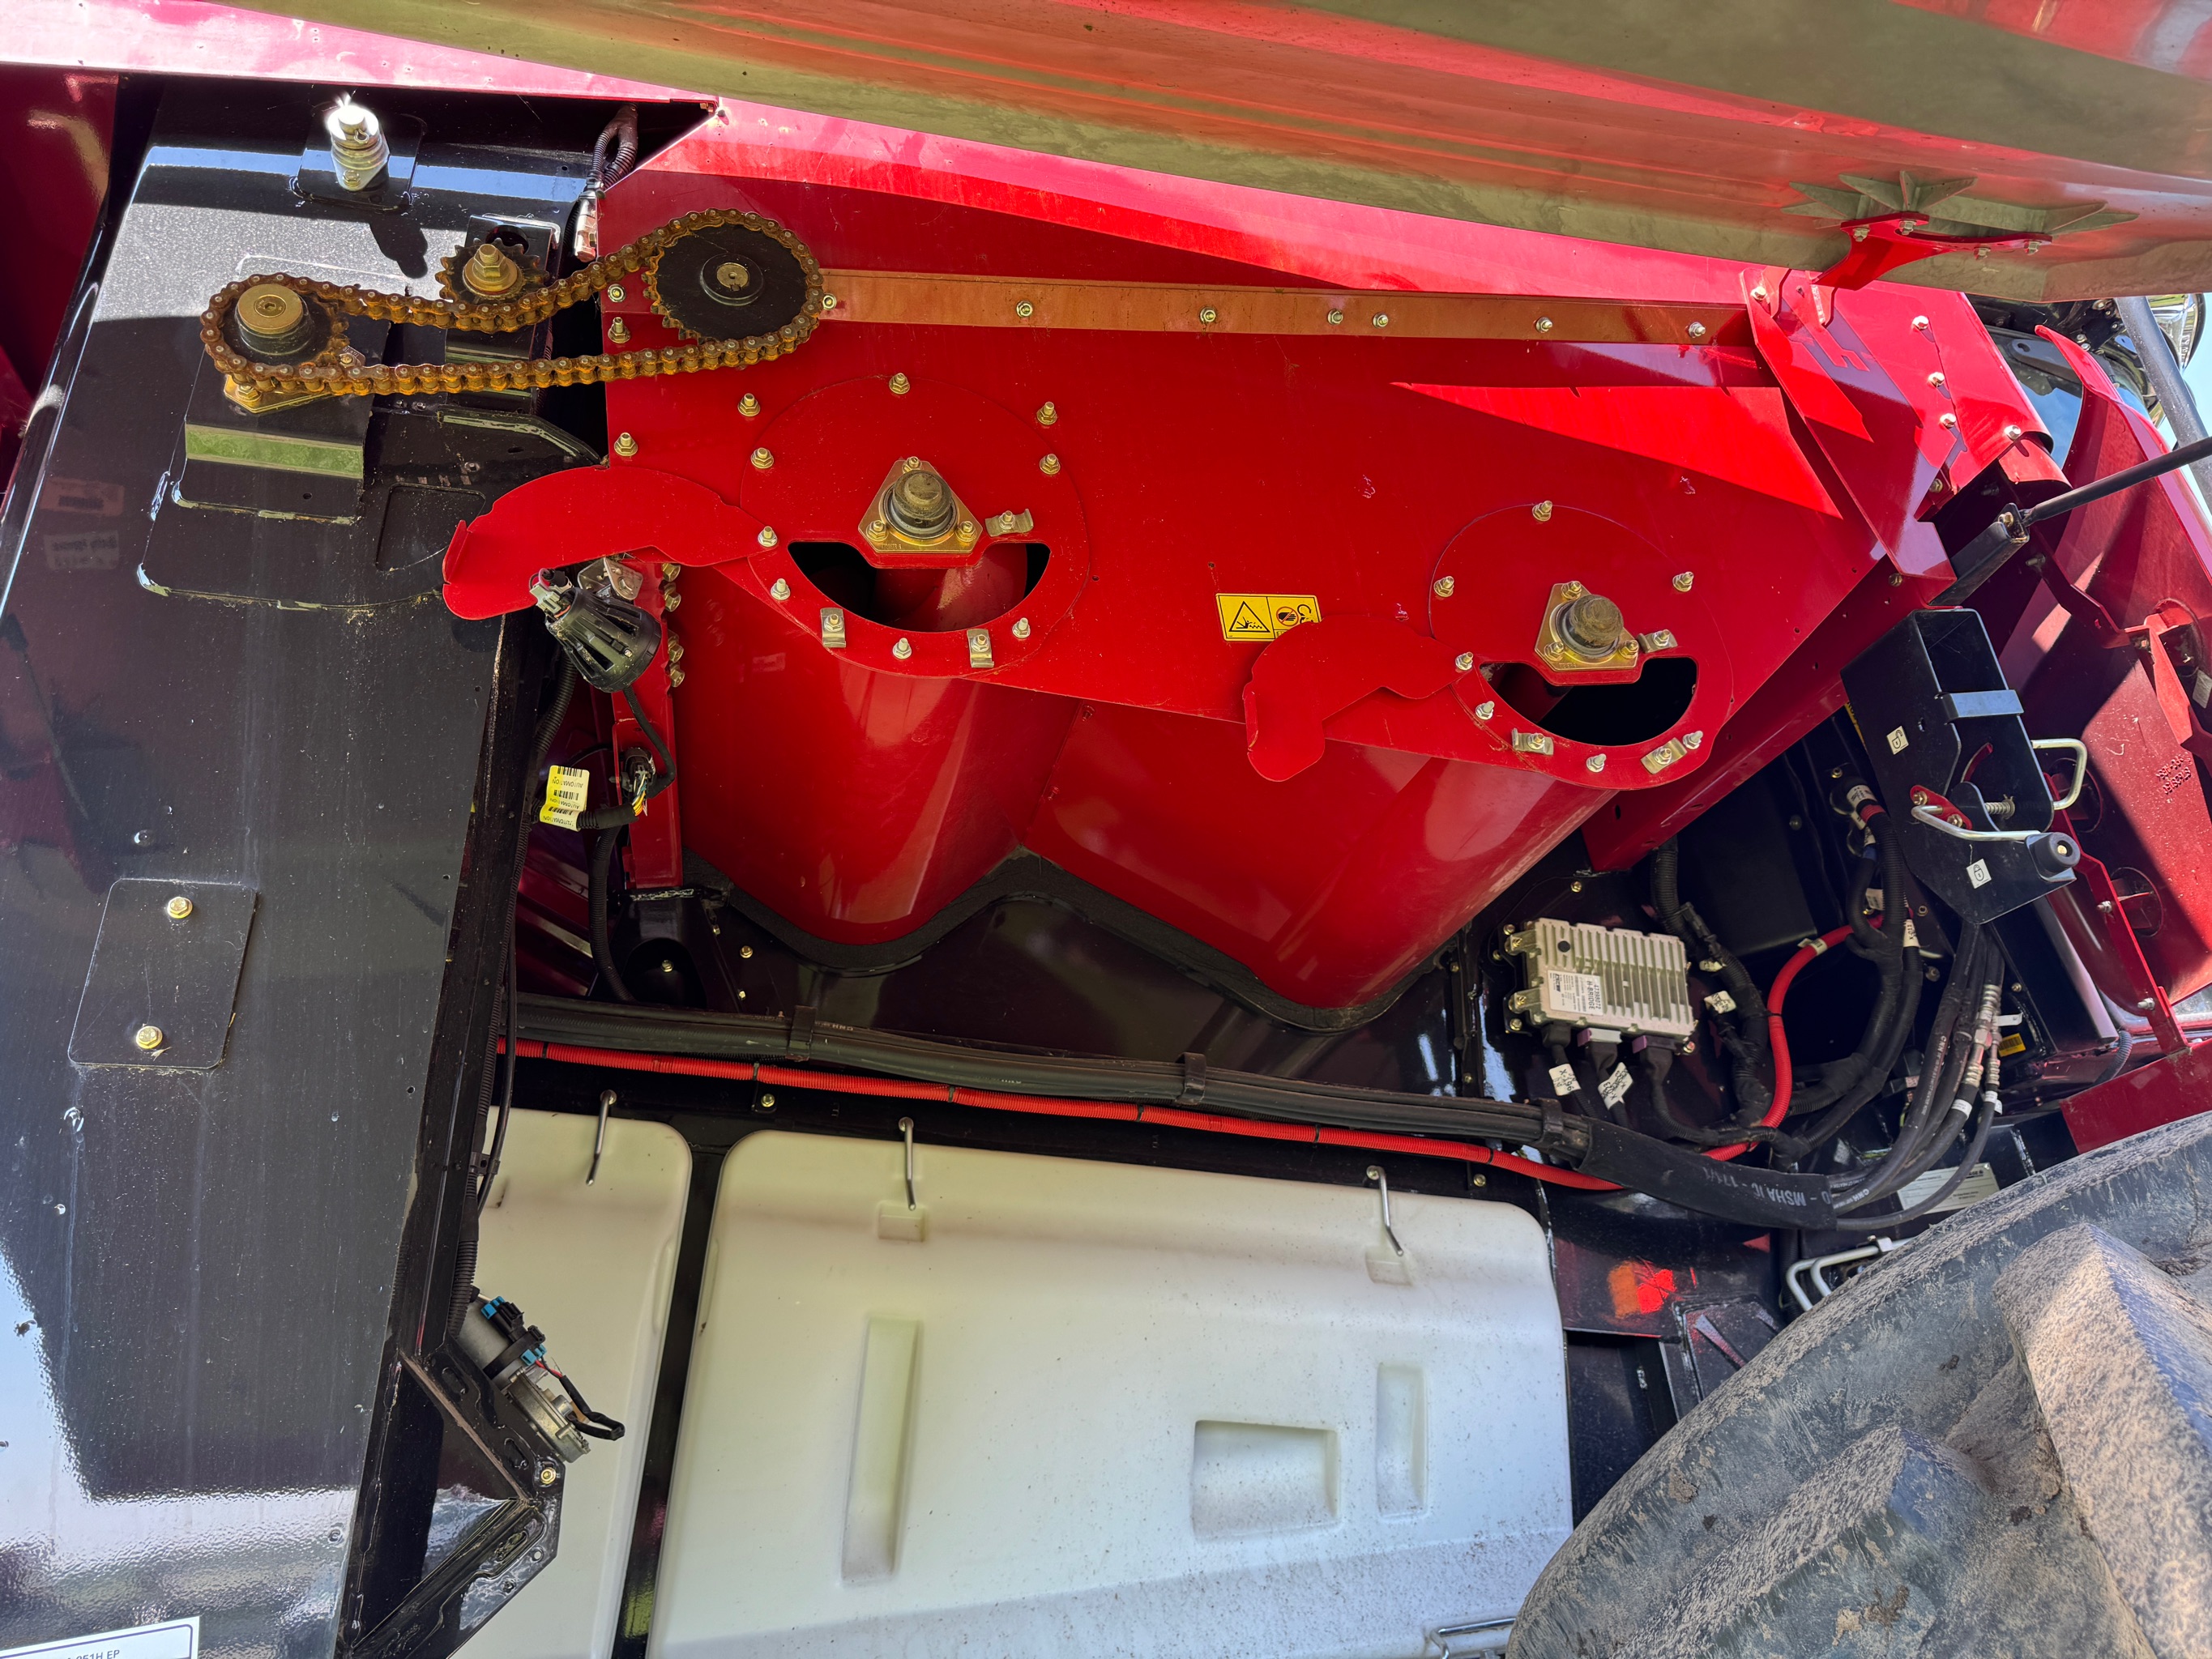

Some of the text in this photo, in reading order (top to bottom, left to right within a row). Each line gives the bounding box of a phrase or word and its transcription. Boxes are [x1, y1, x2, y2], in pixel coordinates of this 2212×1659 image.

[552, 778, 584, 789] AUTOMATION
[549, 798, 580, 809] AUTOMATION
[543, 816, 574, 827] AUTOMATION
[1586, 980, 1595, 1010] H-BRIDGE
[1766, 1188, 1807, 1206] MSHA
[107, 1649, 120, 1659] EP
